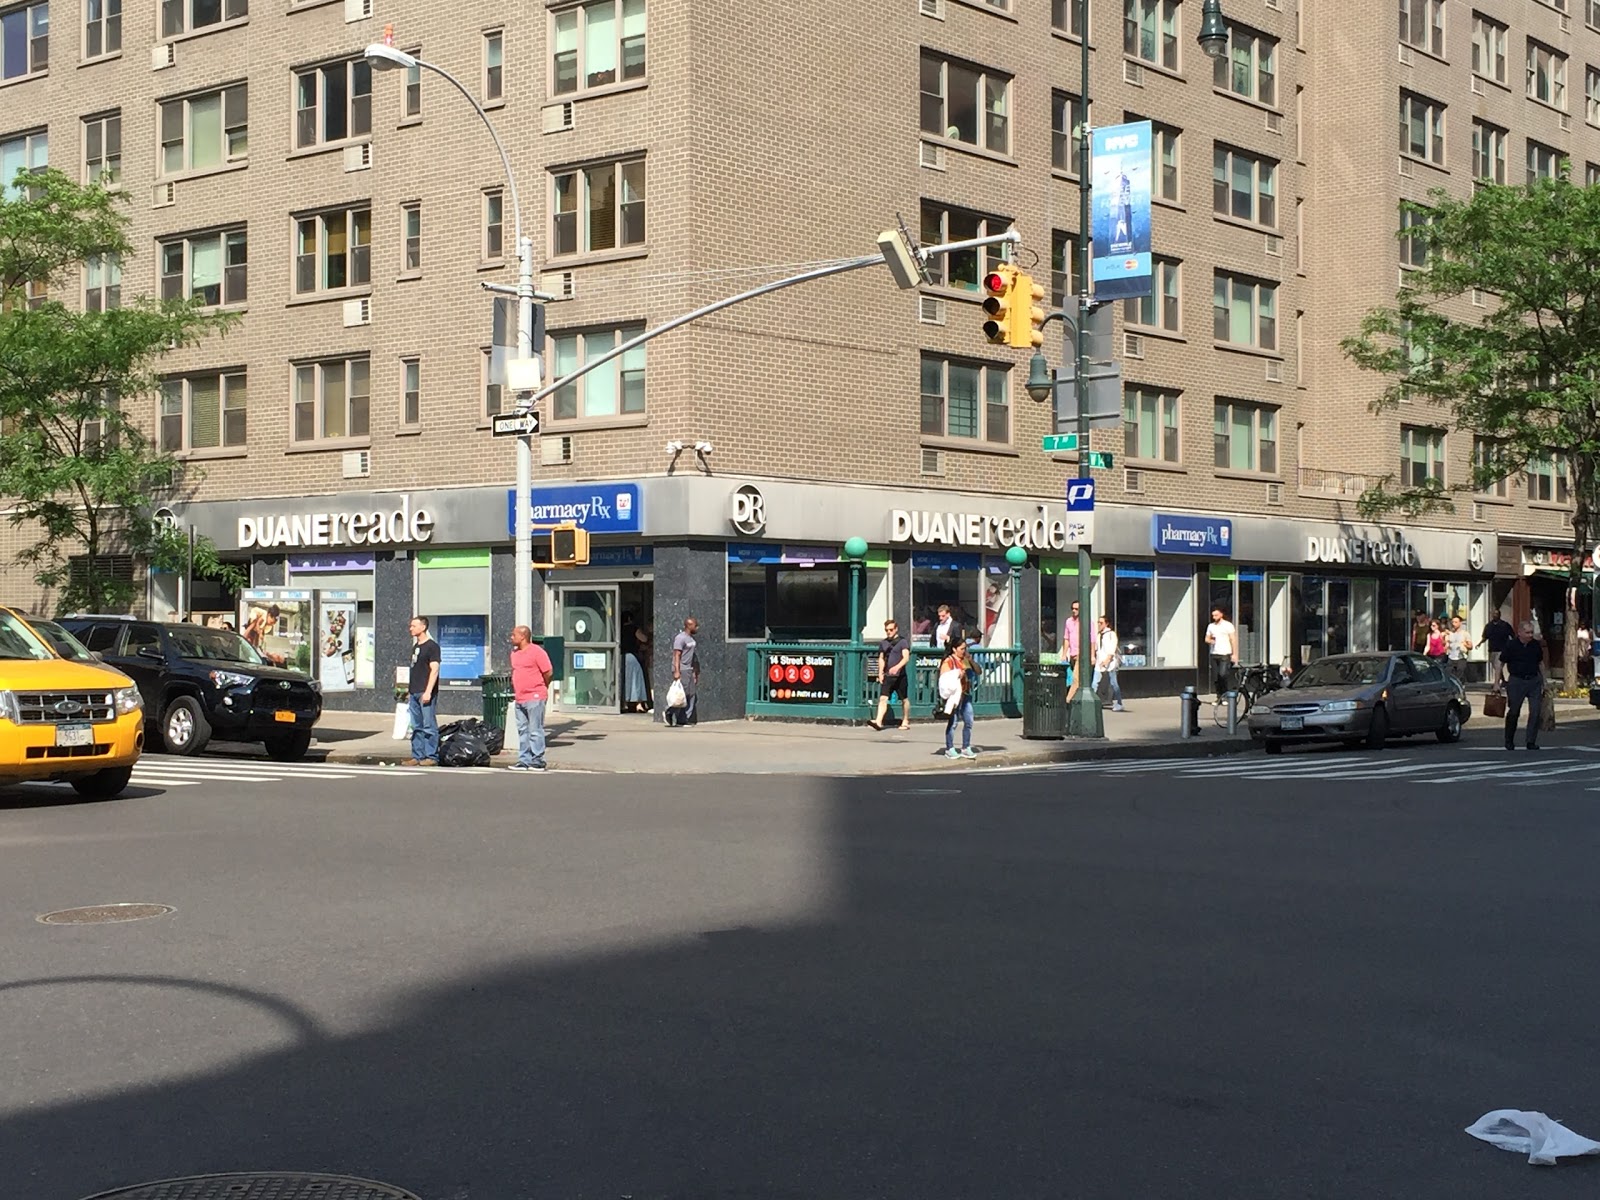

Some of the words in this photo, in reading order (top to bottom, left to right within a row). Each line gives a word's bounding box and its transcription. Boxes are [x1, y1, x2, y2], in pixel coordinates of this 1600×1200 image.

[500, 420, 513, 431] ONE
[1052, 437, 1059, 450] 7
[770, 656, 779, 665] 14
[780, 656, 804, 665] Street
[805, 656, 833, 666] Station
